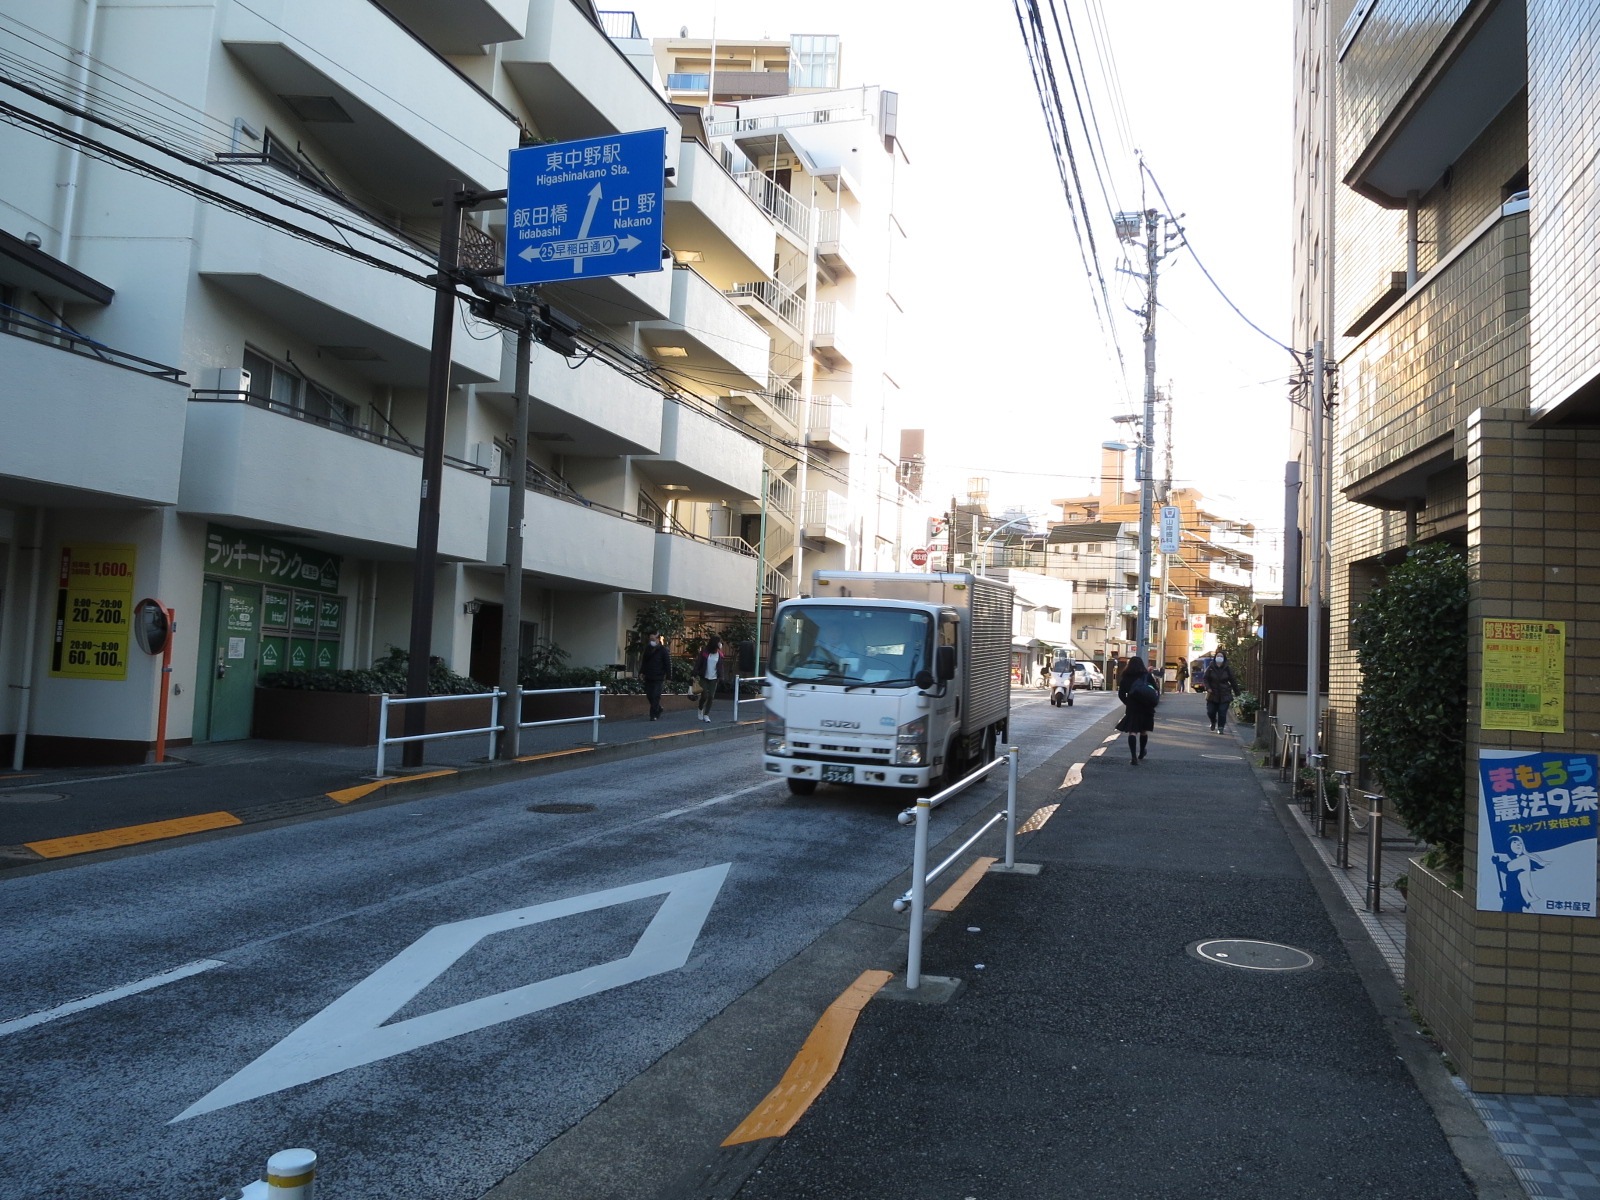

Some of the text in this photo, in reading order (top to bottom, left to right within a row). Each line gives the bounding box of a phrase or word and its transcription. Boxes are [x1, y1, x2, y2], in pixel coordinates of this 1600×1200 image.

[546, 143, 621, 172] 東中野駅
[536, 164, 630, 186] Higashinakano Sta.
[513, 203, 568, 228] 飯田橋
[612, 192, 656, 216] 中野
[519, 225, 561, 240] Iidabashi
[613, 216, 652, 229] Nakano
[541, 239, 613, 257] 25 早稲田通り
[208, 533, 302, 579] ラッキートランク
[820, 719, 861, 730] ISUZU
[1488, 757, 1593, 793] まもろう
[1492, 785, 1599, 823] 憲法9条
[1546, 899, 1591, 912] 日本共産党
